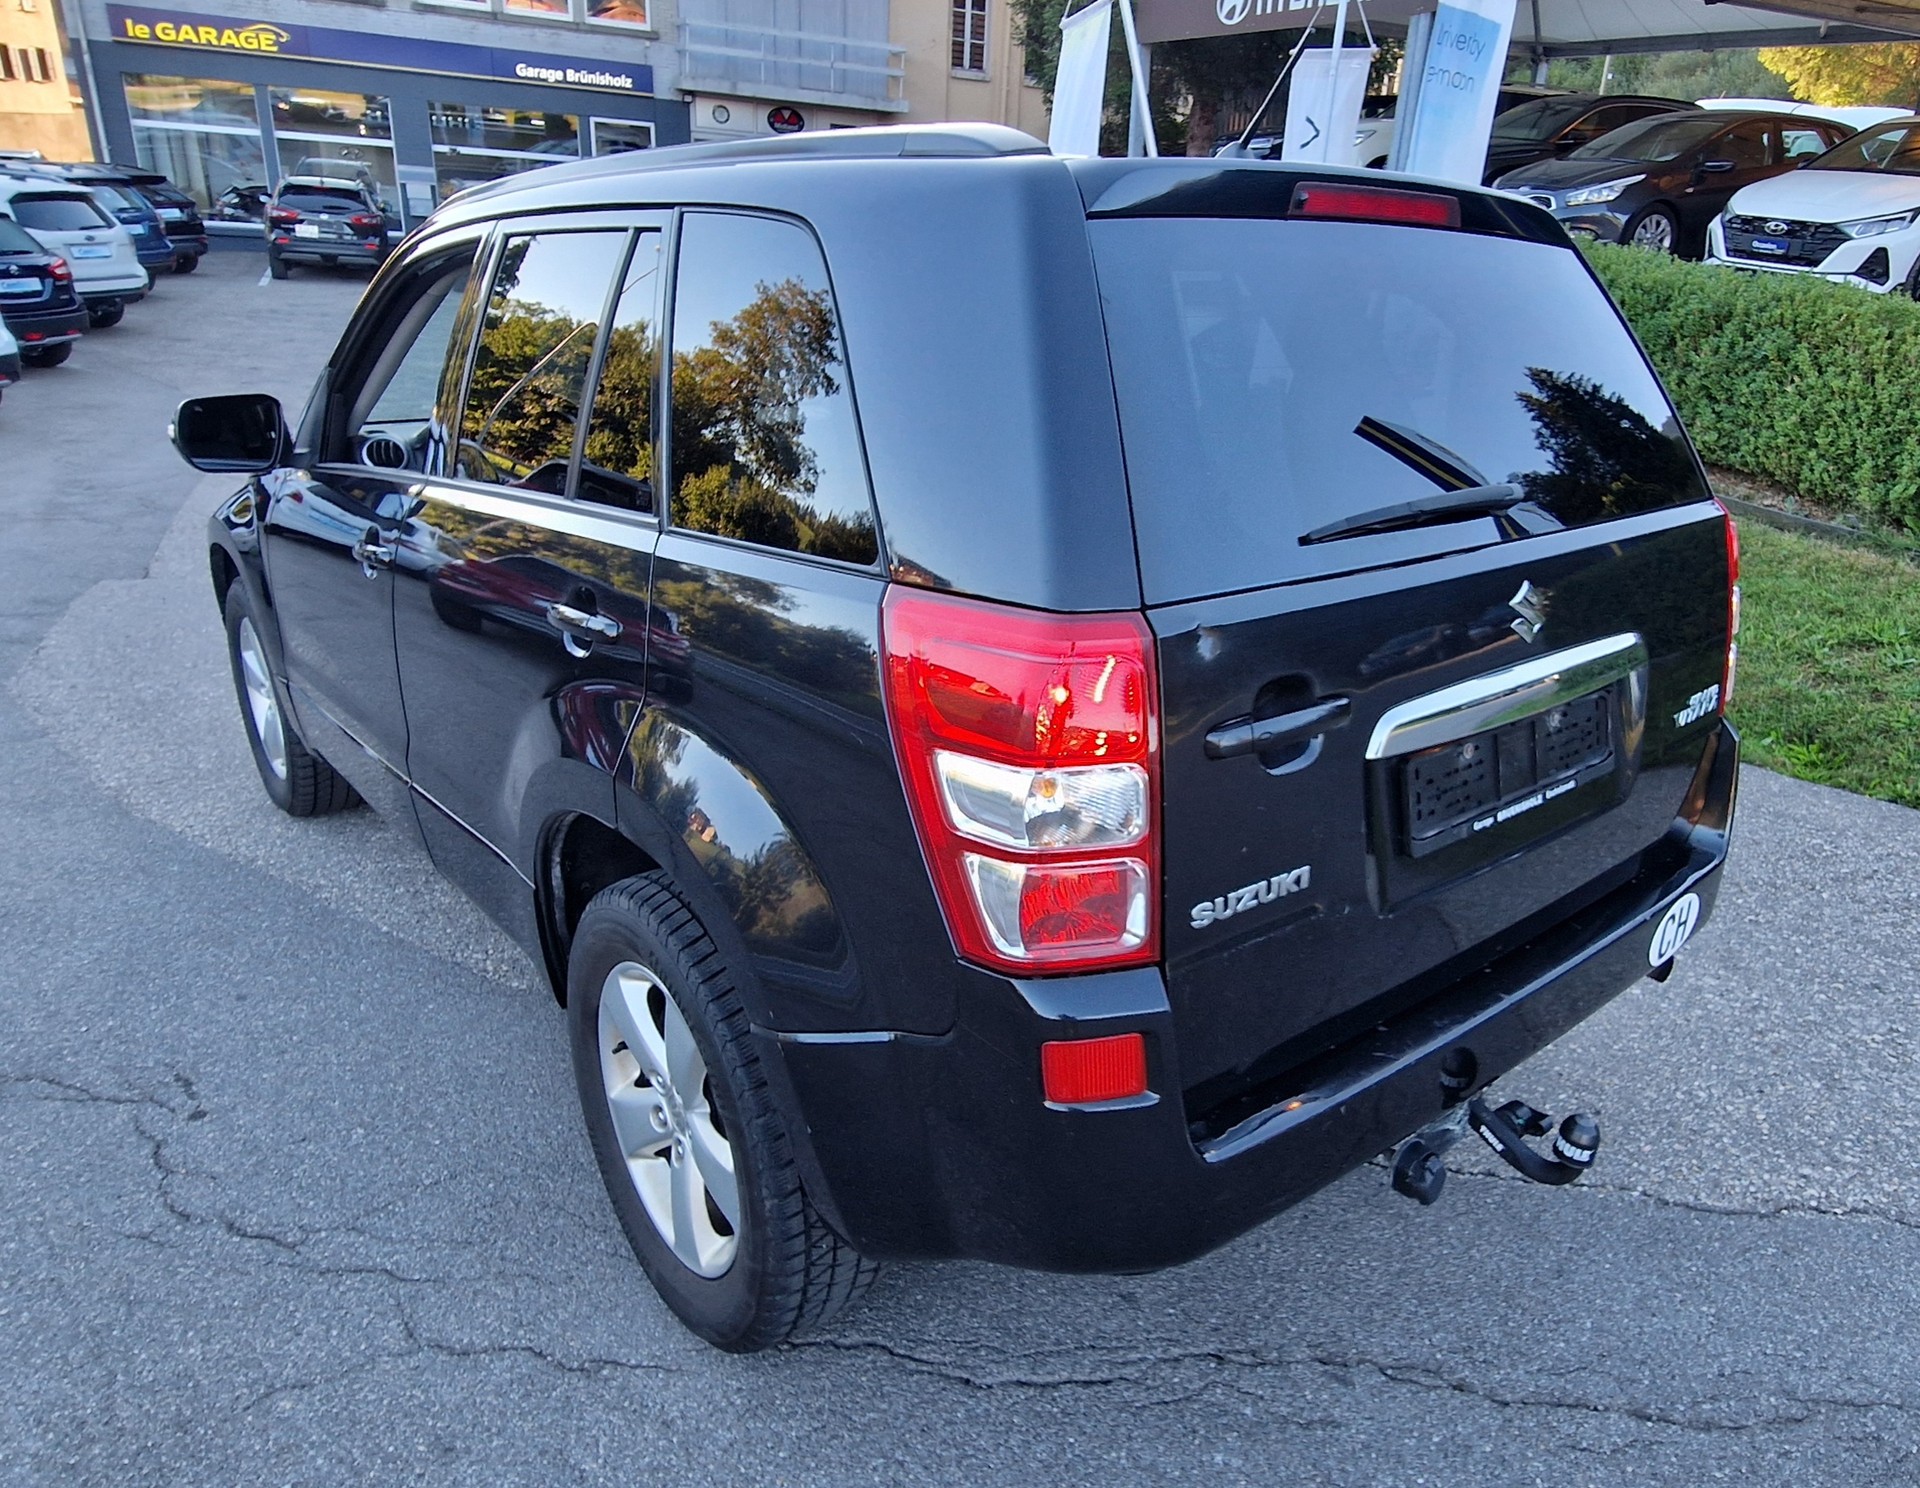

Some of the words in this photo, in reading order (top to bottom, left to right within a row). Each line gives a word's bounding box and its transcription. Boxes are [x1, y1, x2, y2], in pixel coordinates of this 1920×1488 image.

[124, 18, 150, 39] le
[154, 22, 279, 52] GARAGE
[515, 63, 564, 82] Garage
[565, 68, 633, 88] Brünisholz
[1190, 865, 1311, 929] SUZUKI
[1658, 899, 1692, 960] CH
[1480, 1124, 1505, 1152] THULE
[1556, 1135, 1595, 1162] HULE
